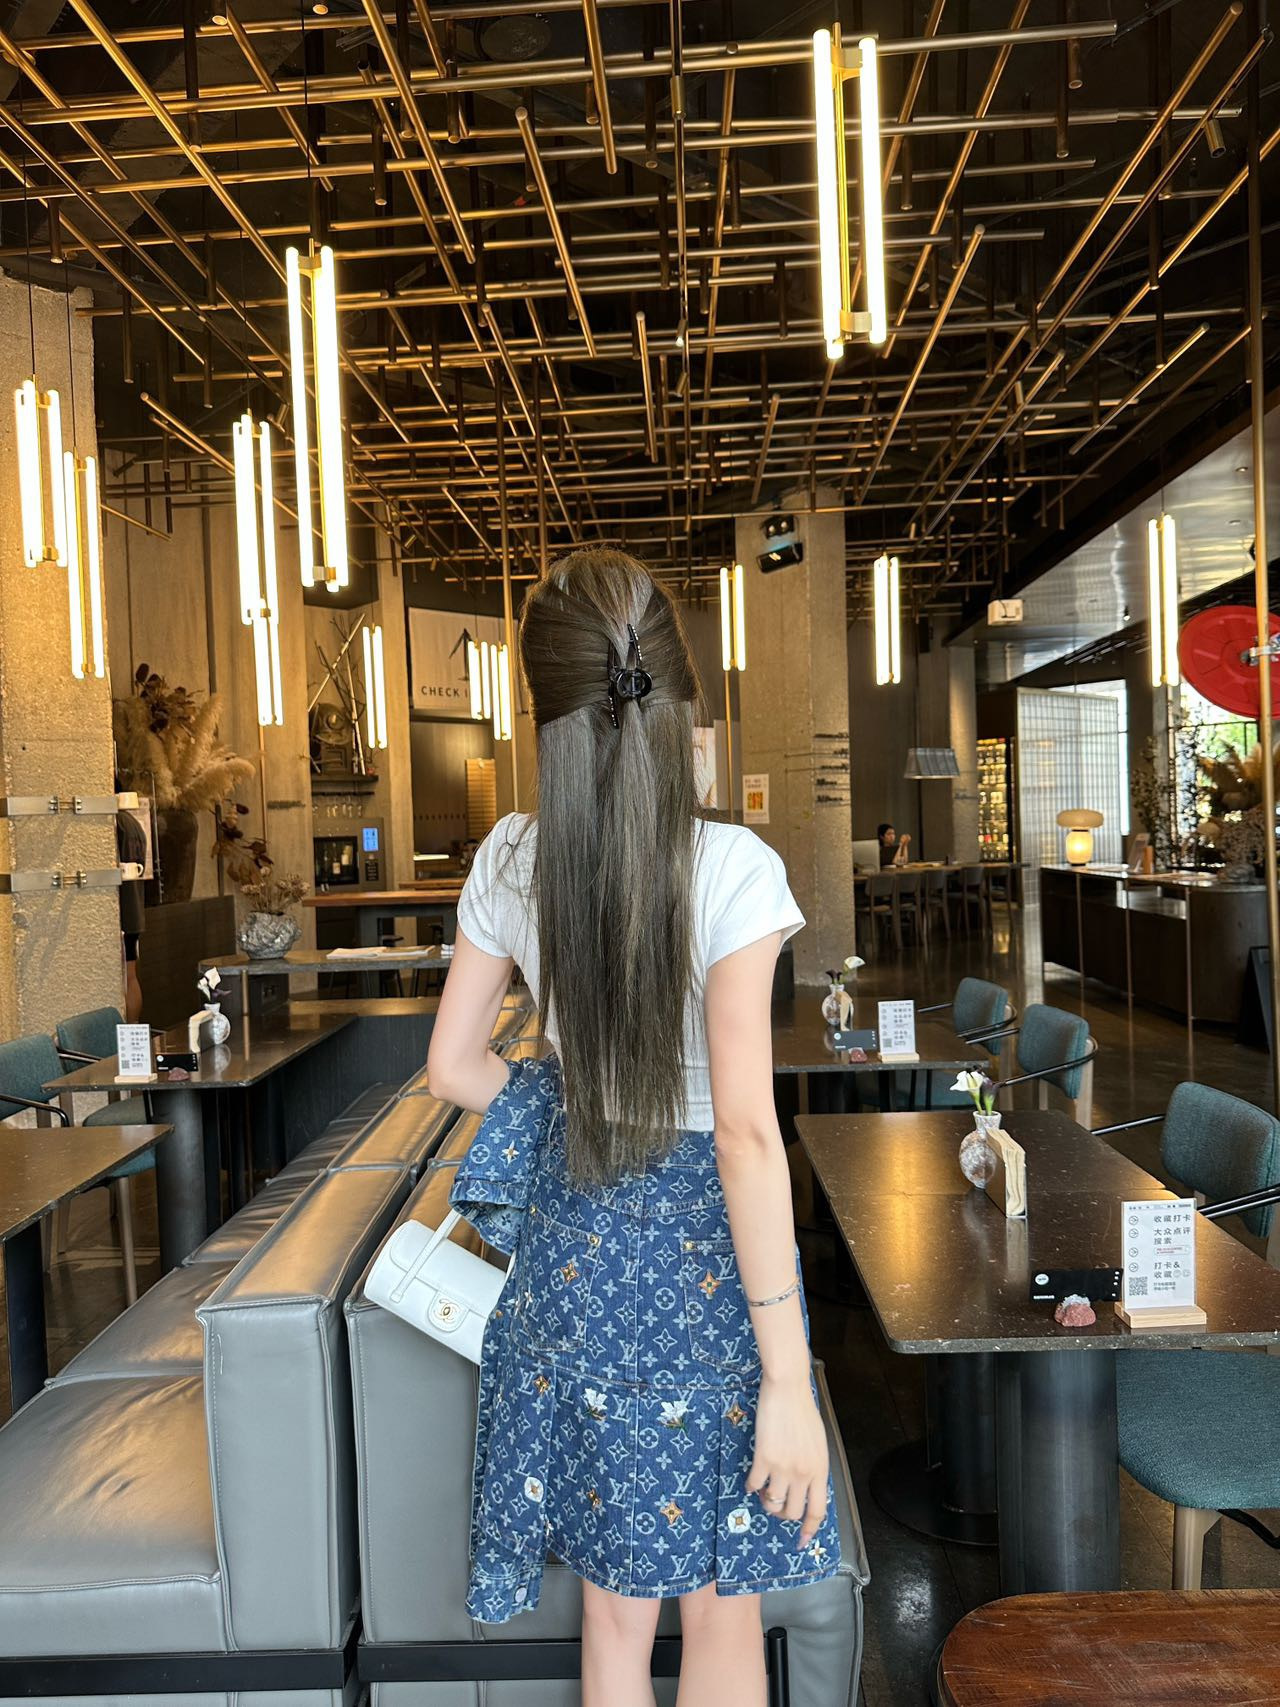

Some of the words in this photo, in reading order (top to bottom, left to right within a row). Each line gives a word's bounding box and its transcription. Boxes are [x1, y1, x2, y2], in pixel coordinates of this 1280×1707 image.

[421, 685, 460, 698] CHECK
[1153, 1227, 1191, 1236] 大众点评
